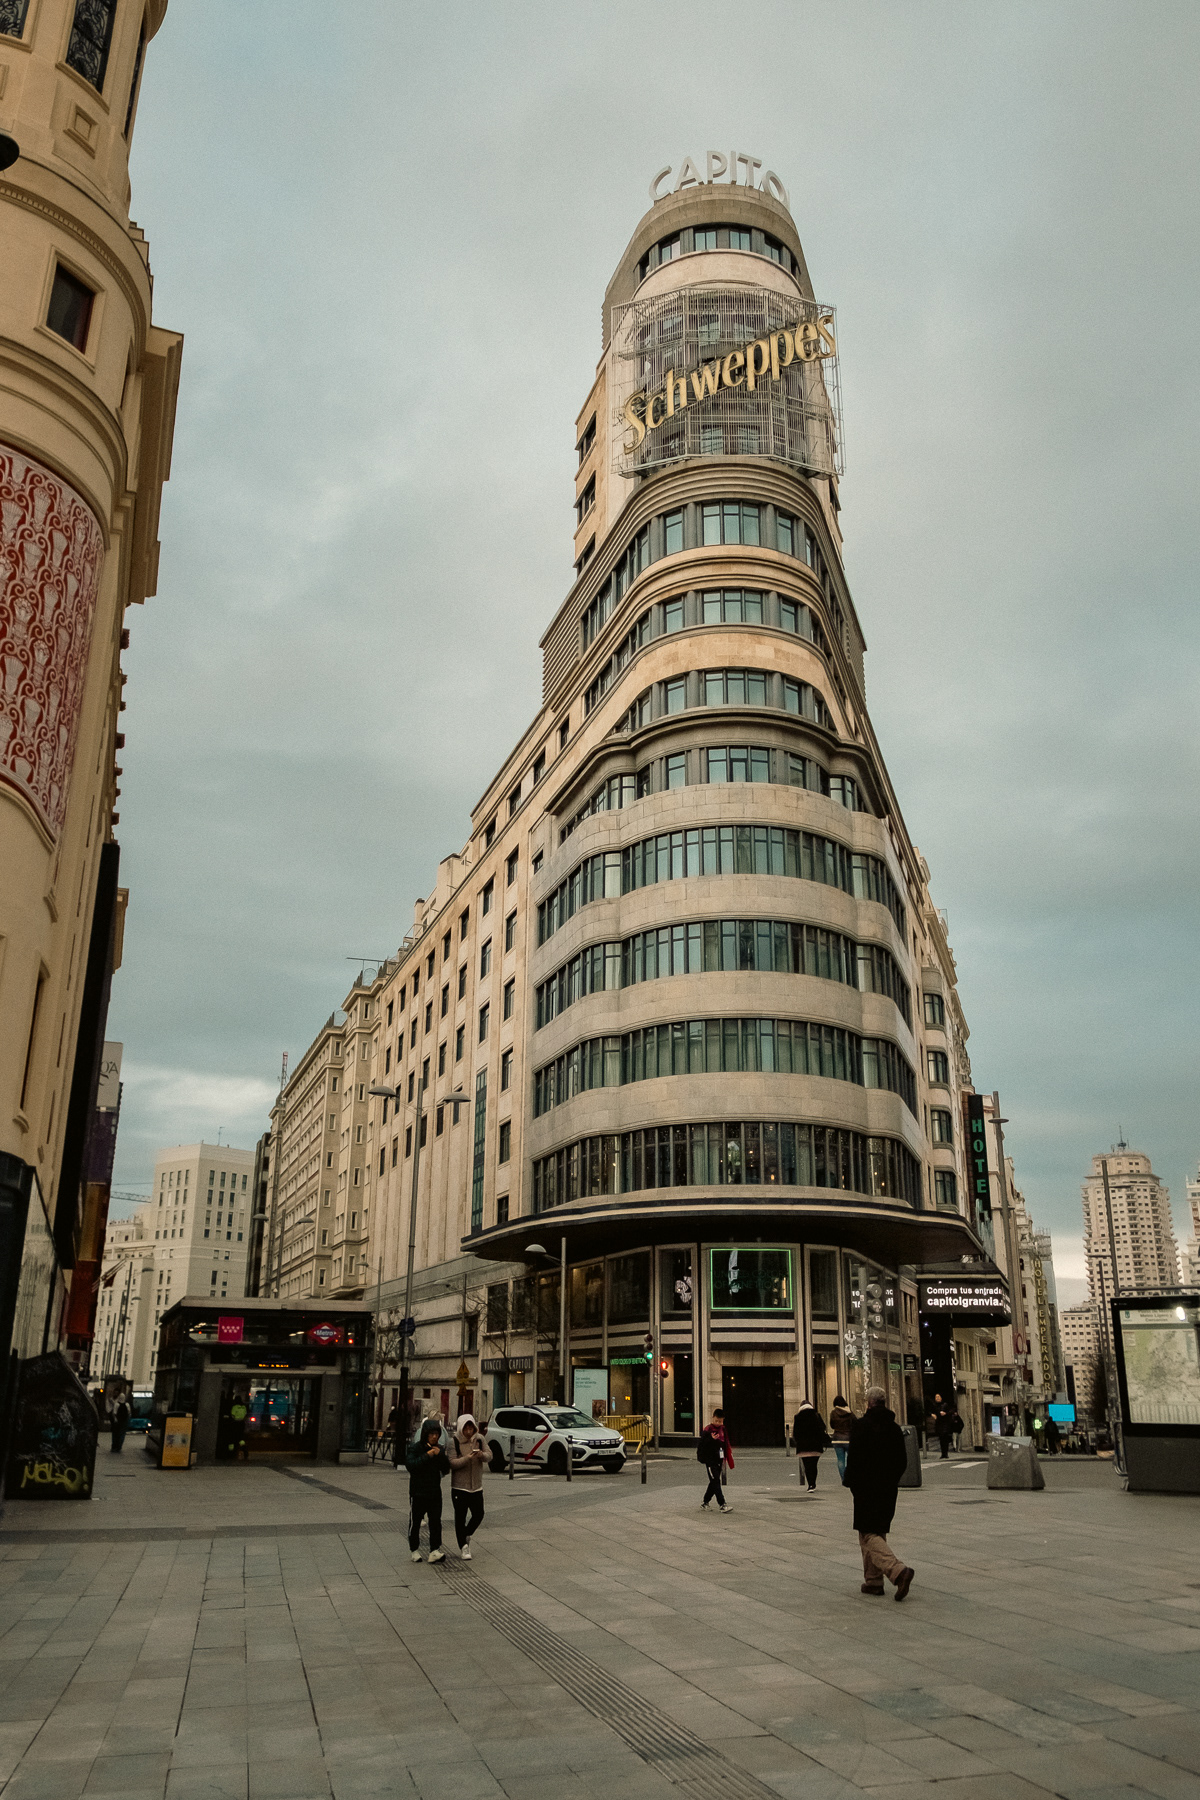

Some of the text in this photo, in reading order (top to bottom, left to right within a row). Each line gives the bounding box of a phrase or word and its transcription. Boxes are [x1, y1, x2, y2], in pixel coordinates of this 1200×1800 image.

[648, 150, 789, 203] CAPITO
[623, 314, 836, 455] Schweppes
[971, 1118, 987, 1214] HOTEL
[926, 1286, 958, 1295] Compra
[959, 1286, 973, 1295] tus
[1034, 1260, 1051, 1390] HOTEL EMPERADOR
[484, 1358, 531, 1370] VINCCI CAPITOL
